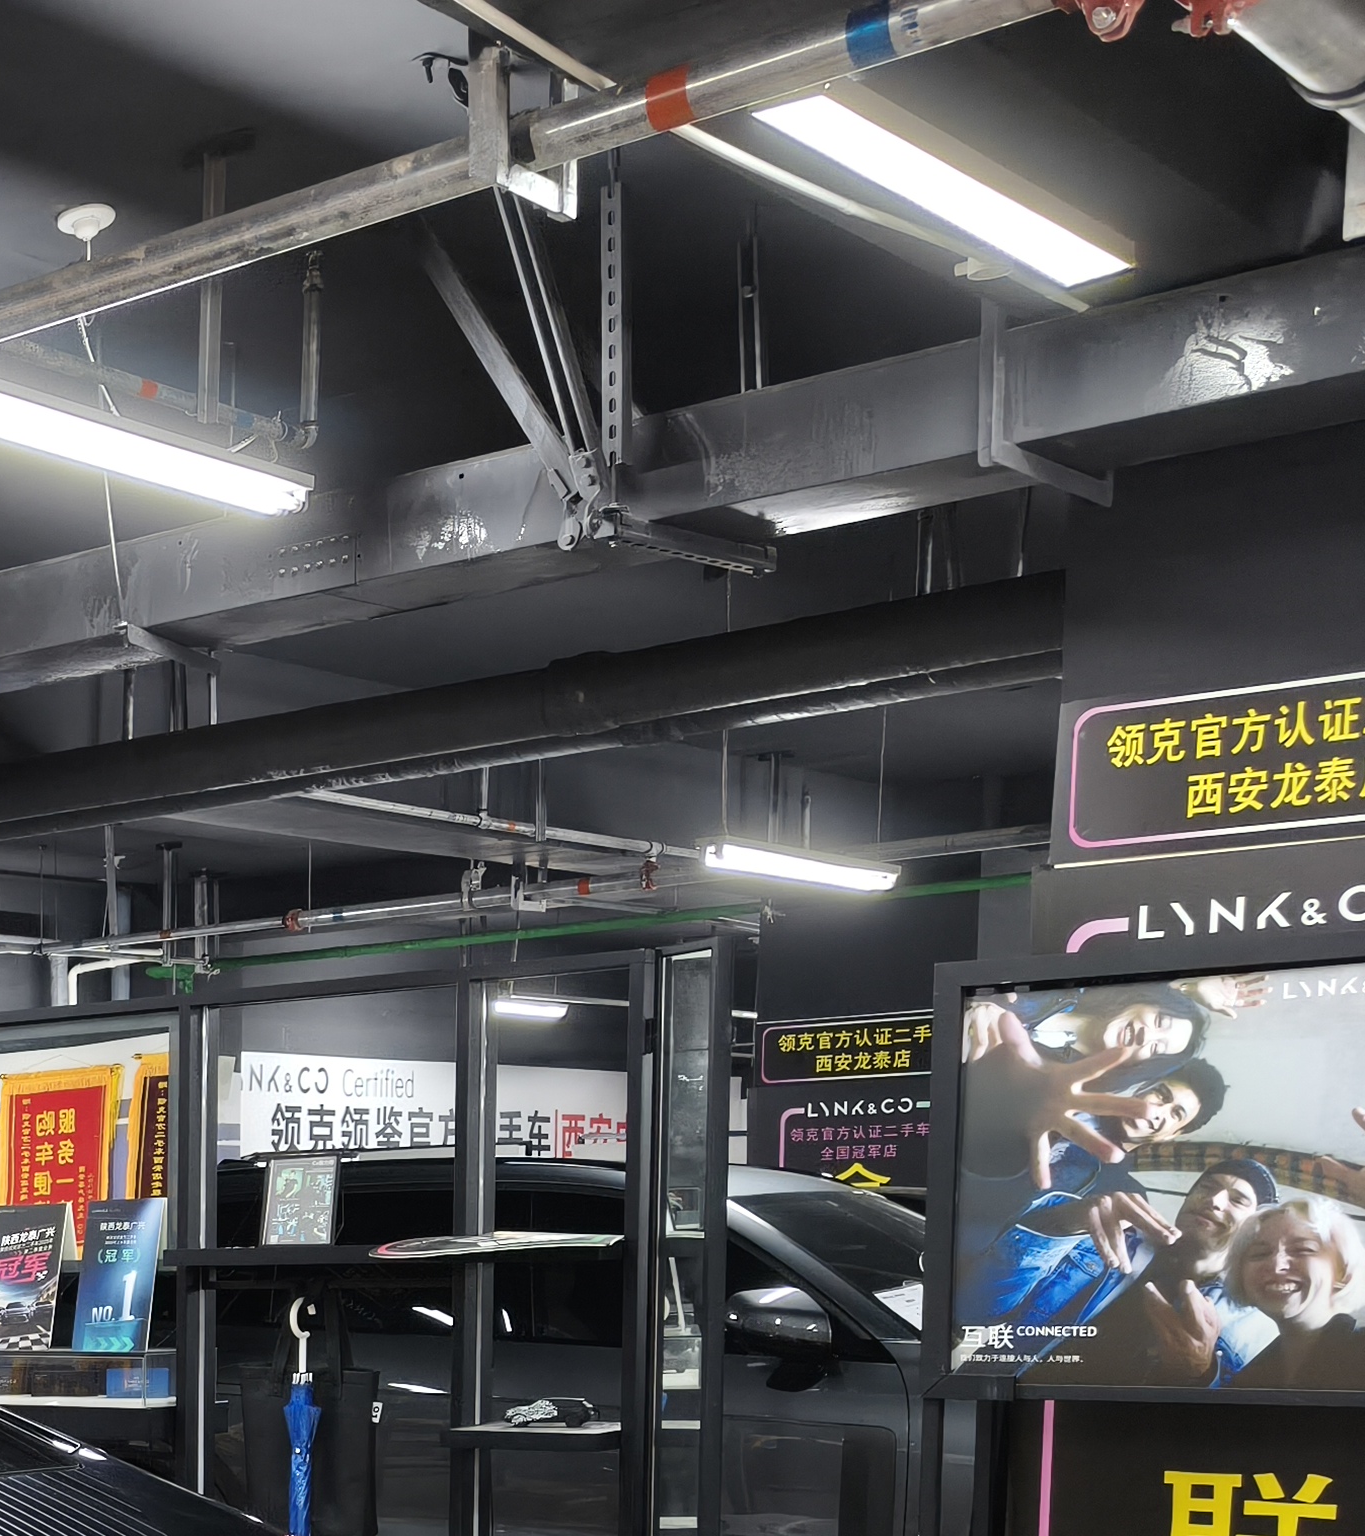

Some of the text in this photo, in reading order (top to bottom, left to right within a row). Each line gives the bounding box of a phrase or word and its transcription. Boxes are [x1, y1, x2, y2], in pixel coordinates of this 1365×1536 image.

[1107, 696, 1365, 768] 领克官方认证
[1186, 757, 1365, 818] 西安龙泰
[778, 1024, 932, 1052] 领克官方认证二手
[816, 1050, 911, 1073] 西安龙泰店
[342, 1069, 415, 1099] Certified
[790, 1122, 930, 1142] 领克官方认证二手车
[820, 1144, 897, 1162] 全国冠军店
[0, 1226, 57, 1247] 陕西龙泰广兴
[962, 1323, 1098, 1349] 互联 CONNECTED
